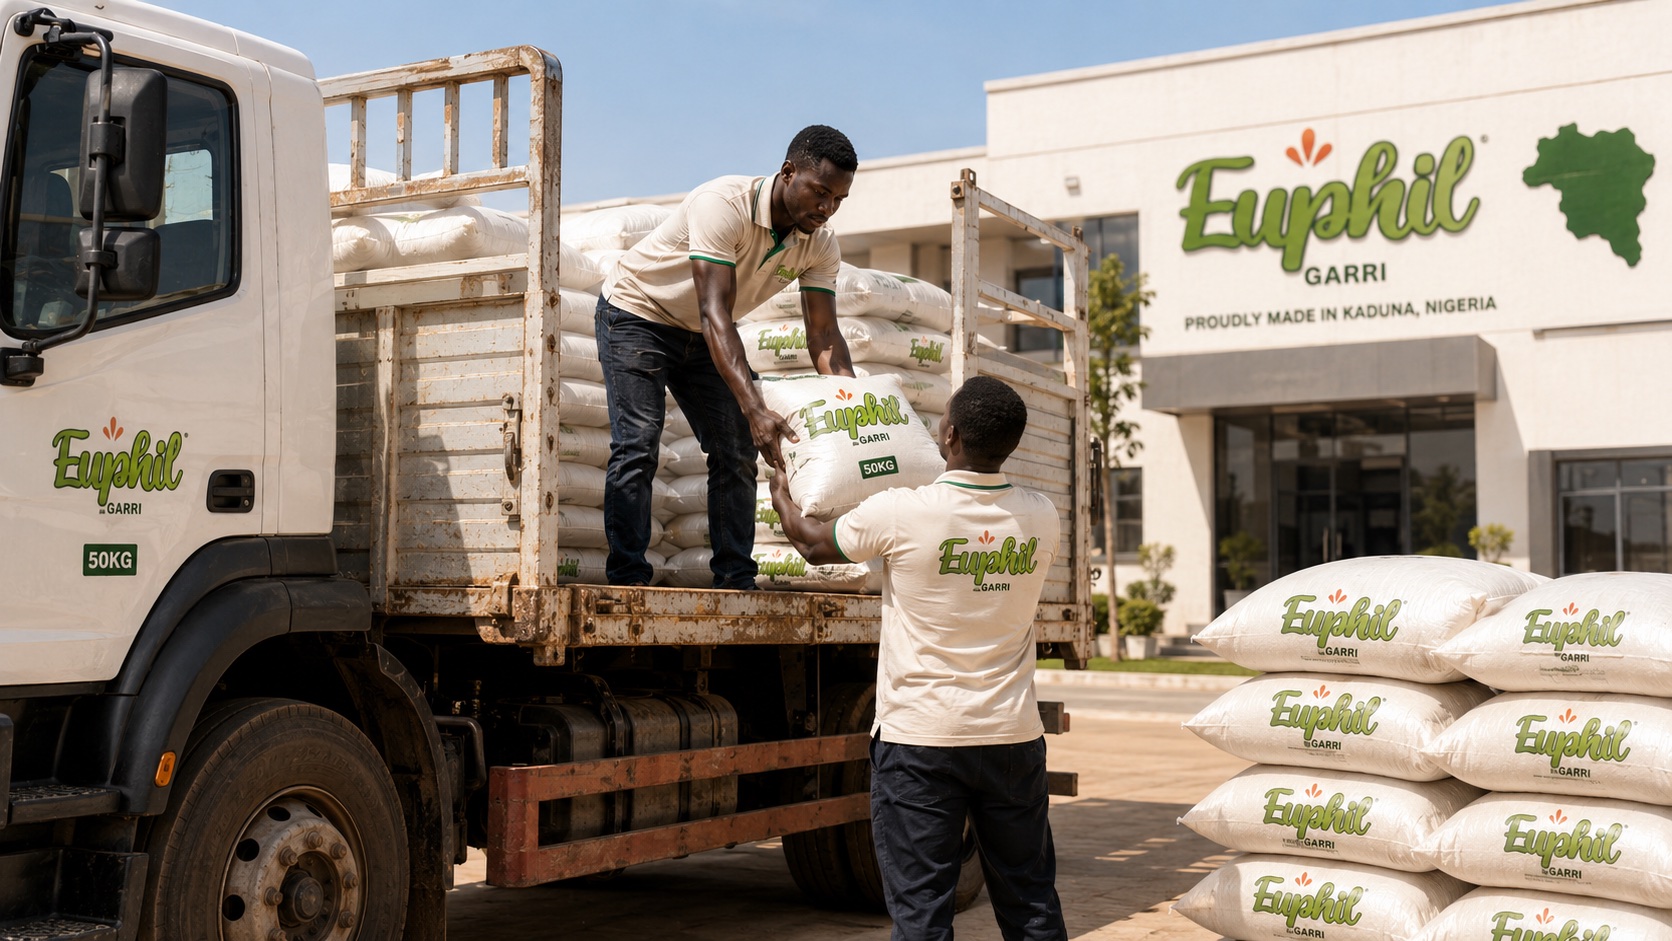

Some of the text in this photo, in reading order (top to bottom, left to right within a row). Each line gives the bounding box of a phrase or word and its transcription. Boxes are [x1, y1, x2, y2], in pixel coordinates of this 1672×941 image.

[1177, 136, 1480, 272] Euphil
[1305, 263, 1387, 285] GARRI
[1185, 296, 1497, 331] PROUDLY MADE IN KADUNA, NIGERIA
[799, 392, 909, 440] Euphil
[860, 432, 890, 444] GARRI
[52, 428, 183, 506] Euphil
[863, 458, 895, 476] 50KG
[107, 503, 142, 515] GARRI
[88, 551, 132, 569] 50KG
[938, 536, 1038, 585] Euphil
[982, 583, 1010, 592] GARRI
[1281, 594, 1402, 646] Euphil
[1524, 608, 1623, 651] Euphil
[1325, 646, 1358, 658] GARRI
[1561, 652, 1590, 663] GARRI
[1270, 689, 1382, 741] Euphil
[1312, 739, 1342, 750] GARRI
[1515, 714, 1632, 768] Euphil
[1559, 767, 1591, 778] GARRI
[1263, 788, 1373, 839] Euphil
[1304, 838, 1335, 849] GARRI
[1504, 813, 1623, 868] Euphil
[1549, 868, 1582, 879] GARRI
[1253, 875, 1364, 928] Euphil
[1294, 927, 1325, 938] GARRI
